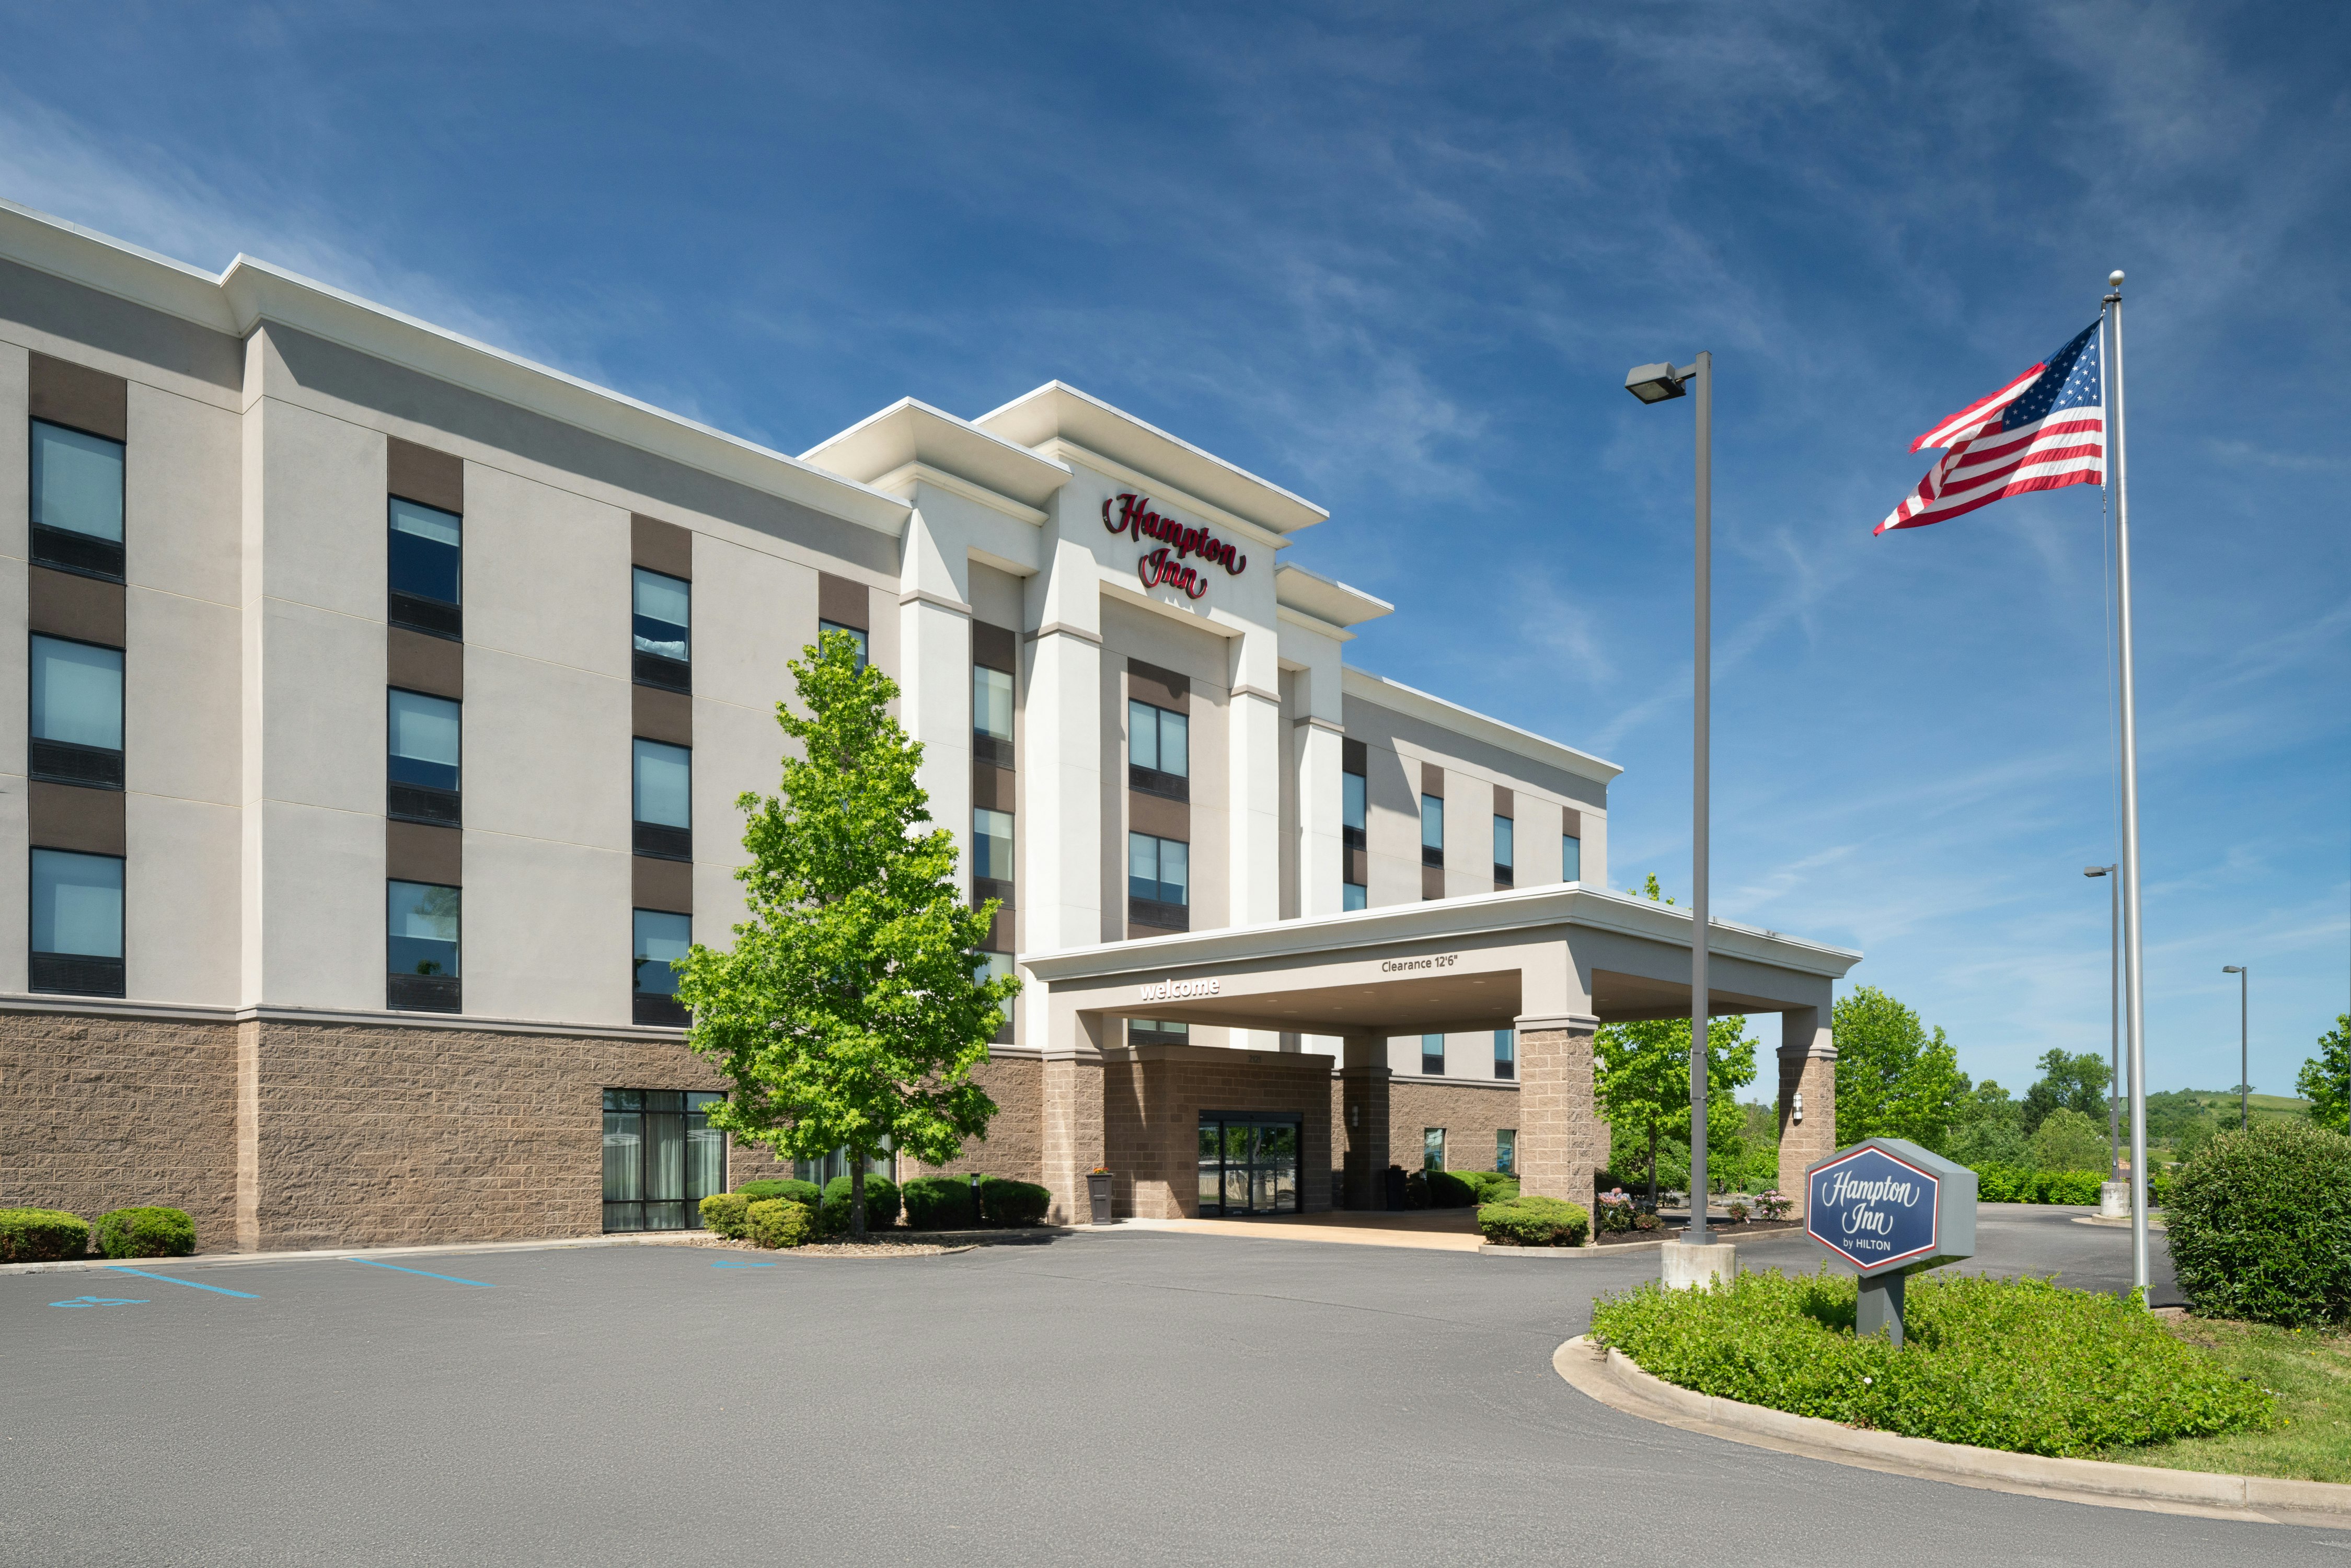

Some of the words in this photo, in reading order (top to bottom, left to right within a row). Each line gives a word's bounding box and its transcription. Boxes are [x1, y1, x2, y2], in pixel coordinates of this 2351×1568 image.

[1102, 493, 1247, 575] Hampton
[1138, 548, 1207, 599] Inn
[1381, 960, 1432, 972] Clearance
[1435, 954, 1458, 967] 12'6"
[1140, 978, 1220, 1000] welcome
[1822, 1170, 1920, 1207] Hampton
[1841, 1203, 1893, 1235] Inn
[1843, 1238, 1853, 1249] by
[1856, 1239, 1891, 1251] HILTON
